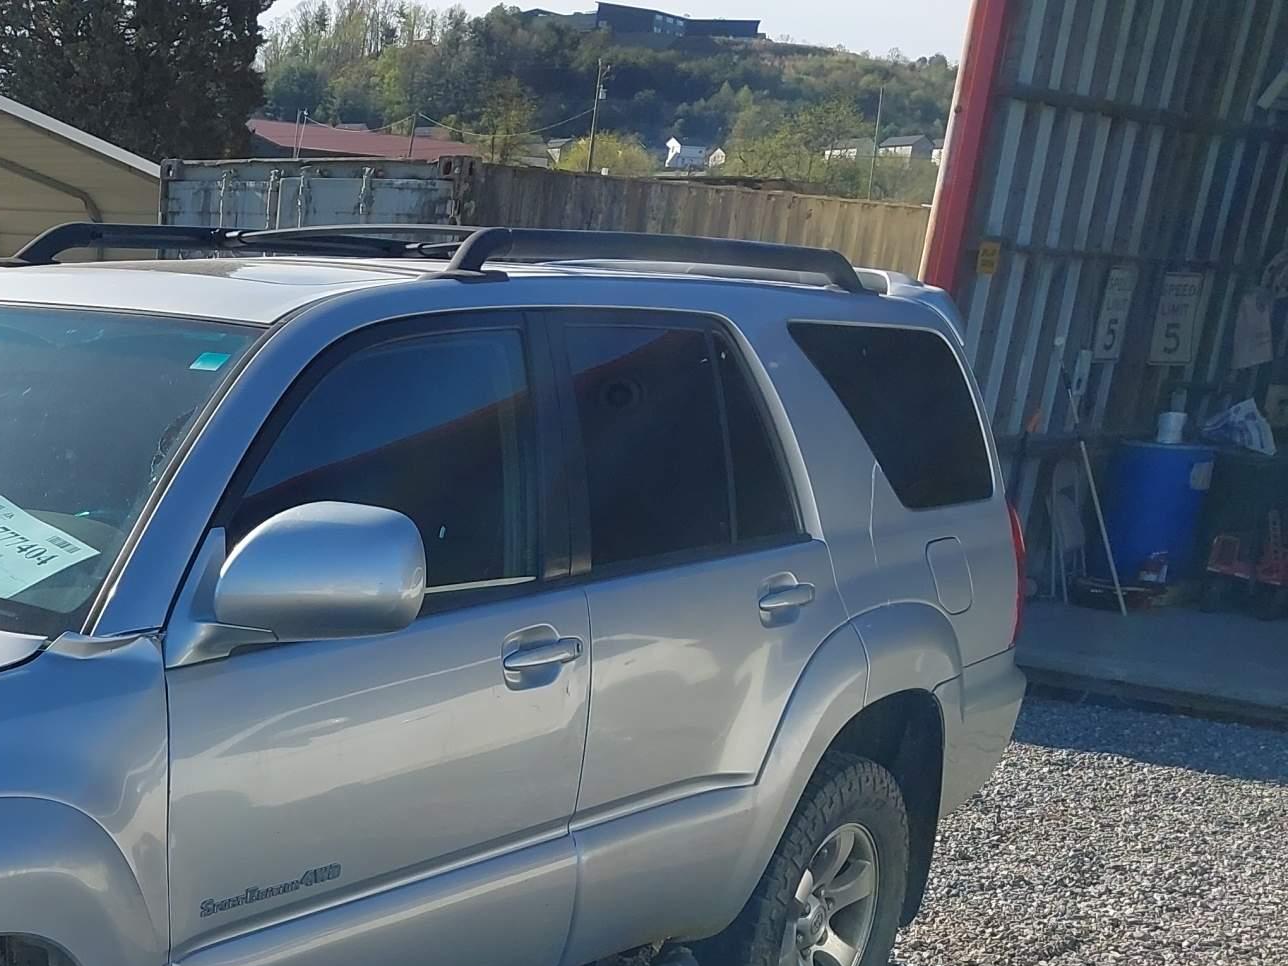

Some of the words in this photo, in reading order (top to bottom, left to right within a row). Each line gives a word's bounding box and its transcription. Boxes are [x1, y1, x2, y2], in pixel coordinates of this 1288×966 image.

[1161, 303, 1190, 316] LIMIT
[1103, 318, 1119, 351] 5
[1163, 322, 1181, 354] 5
